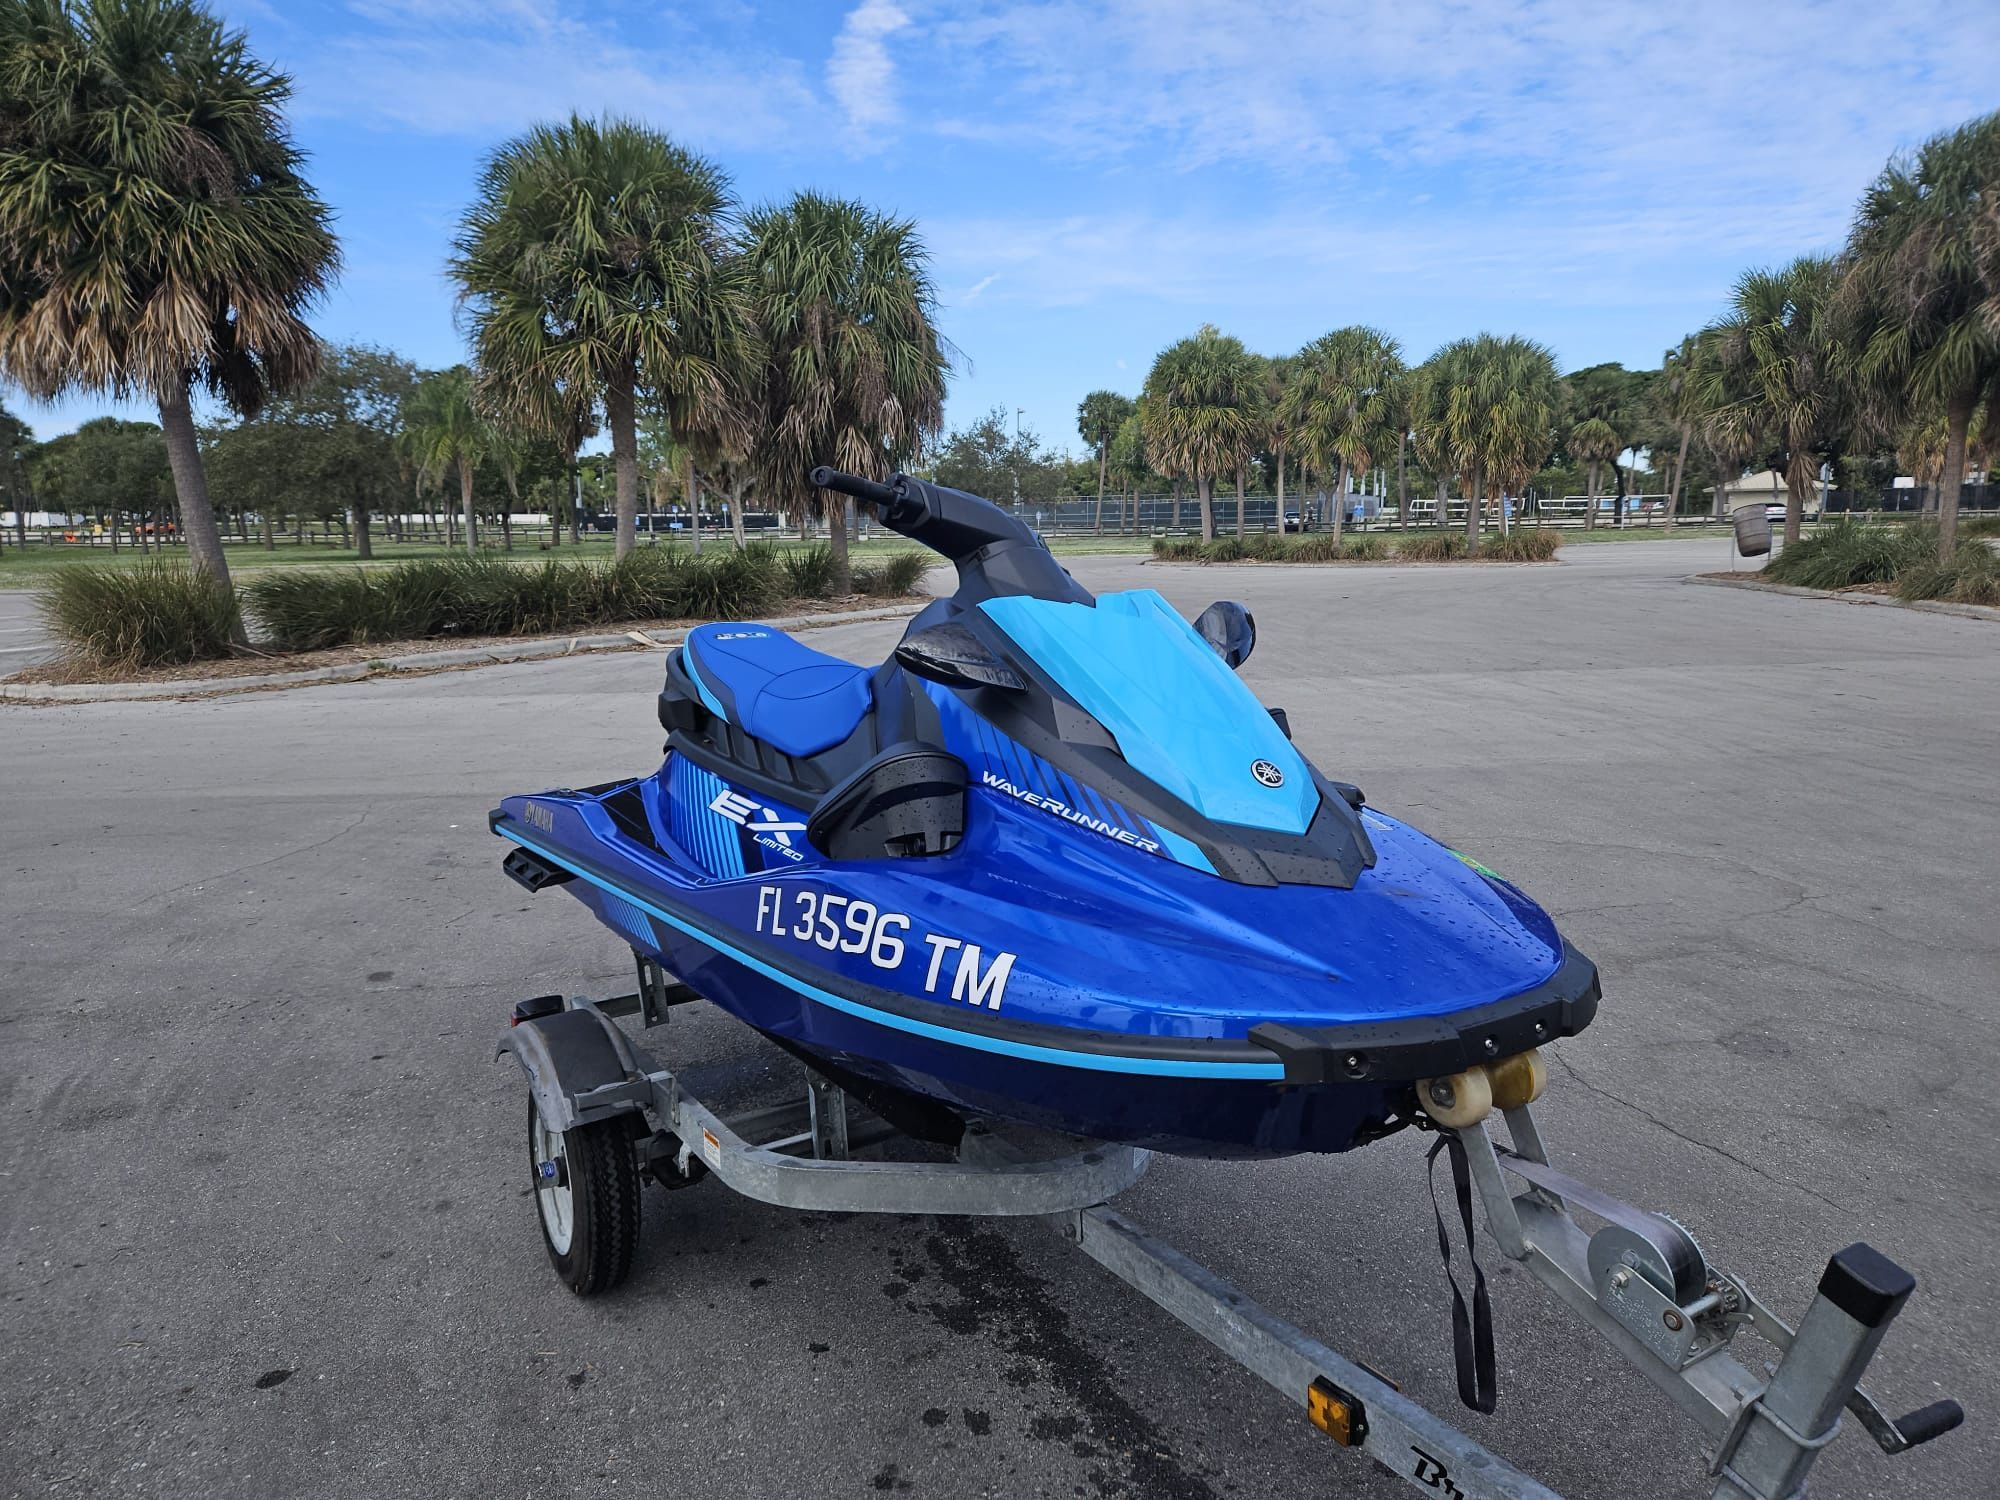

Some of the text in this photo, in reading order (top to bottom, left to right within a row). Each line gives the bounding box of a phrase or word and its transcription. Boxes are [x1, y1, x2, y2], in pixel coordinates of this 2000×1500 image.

[708, 789, 808, 847] EX
[982, 770, 1160, 853] WAVERUNNER
[752, 833, 804, 862] LIMITED
[755, 886, 1017, 1011] FL 3596 TM
